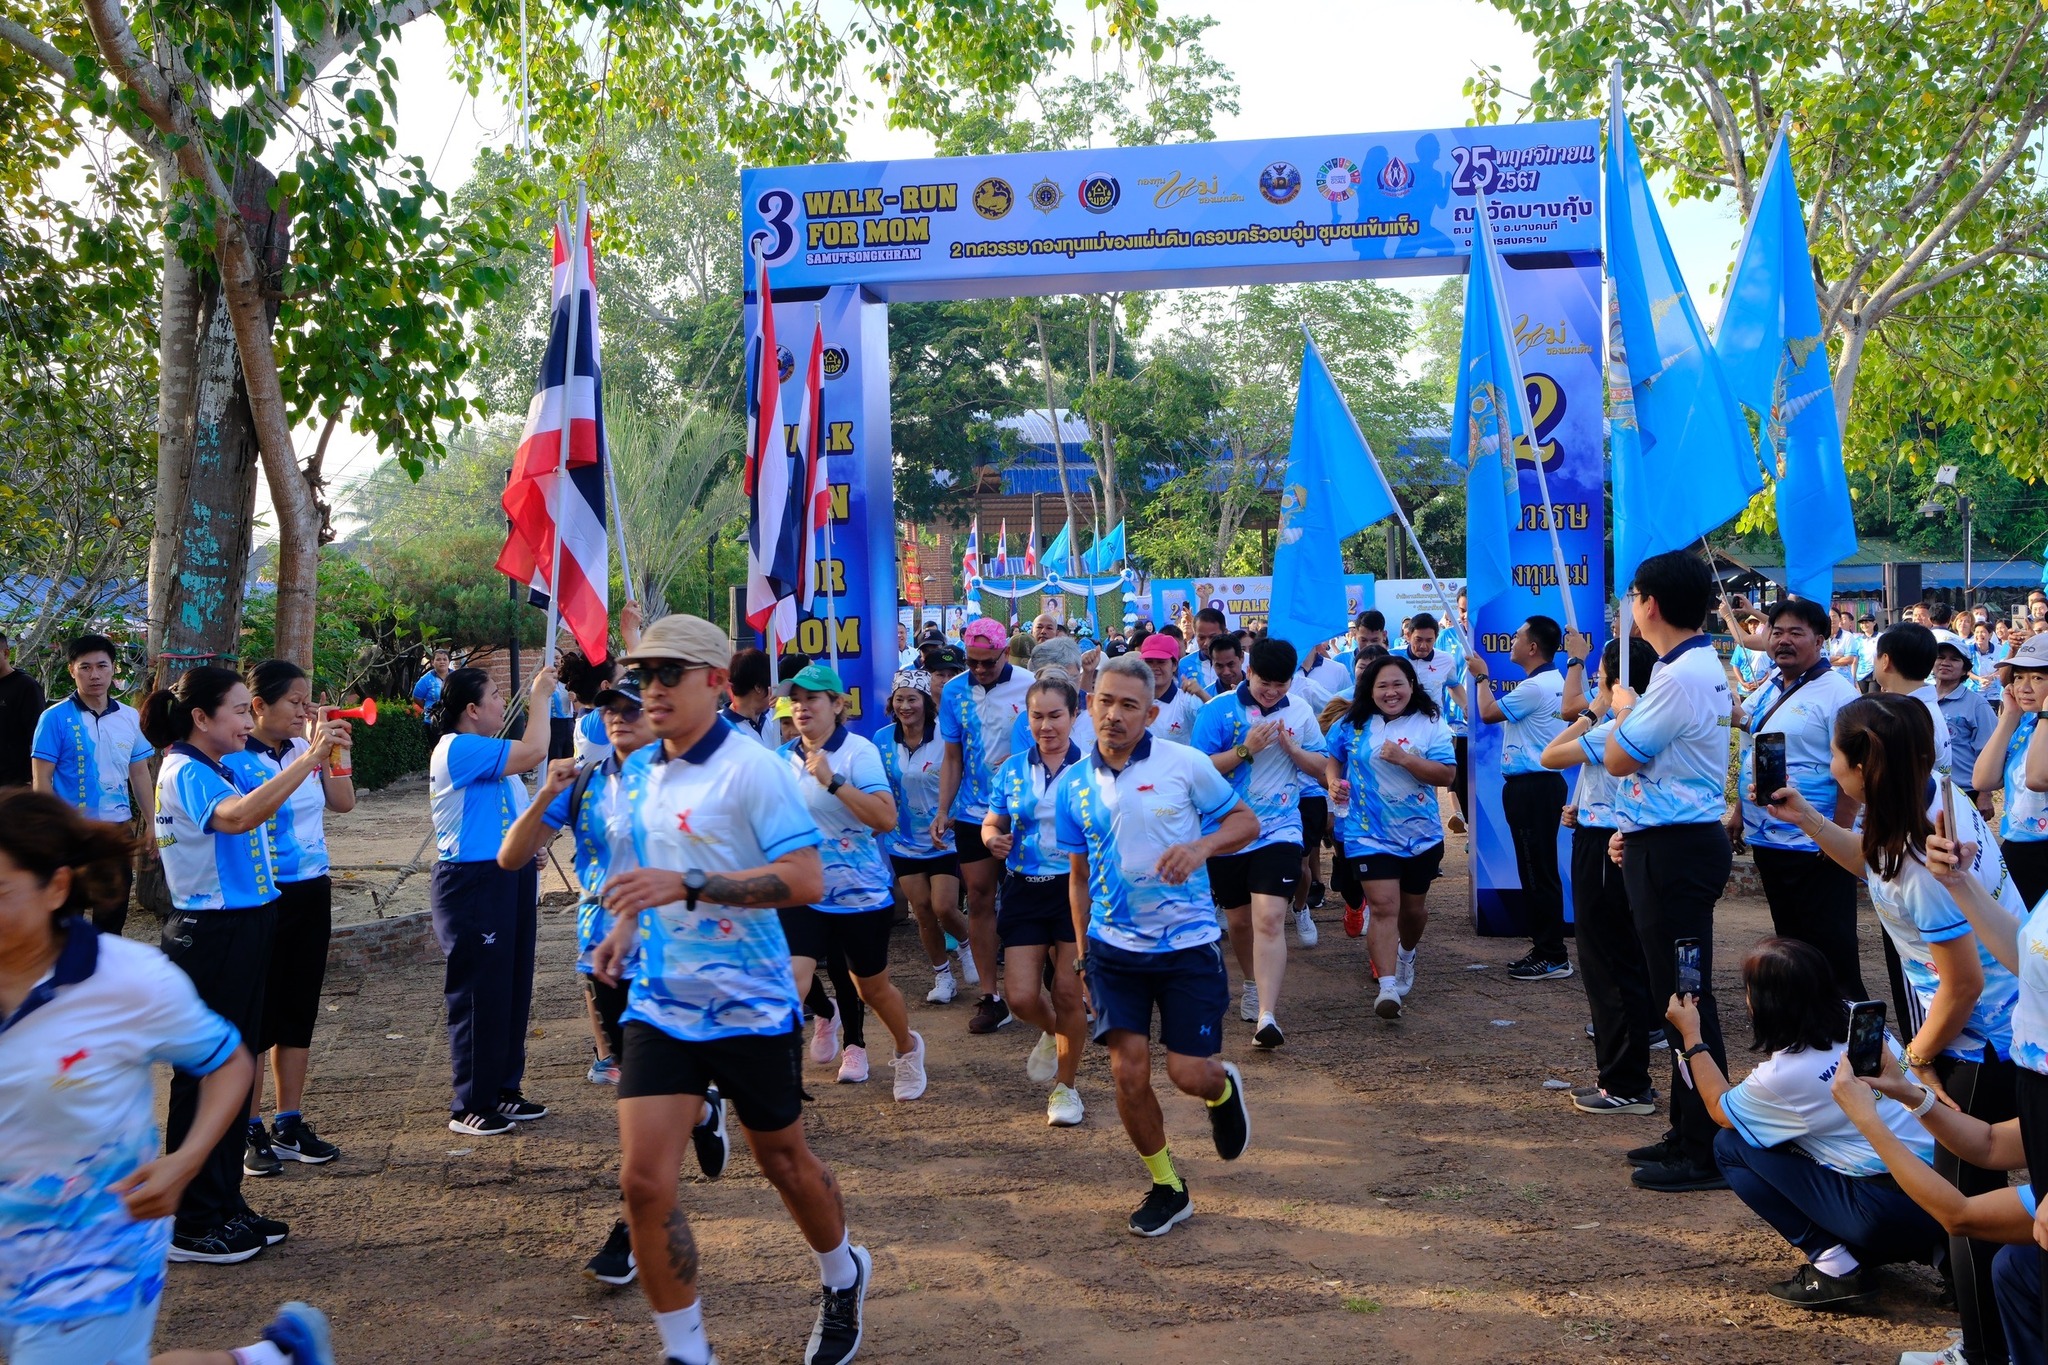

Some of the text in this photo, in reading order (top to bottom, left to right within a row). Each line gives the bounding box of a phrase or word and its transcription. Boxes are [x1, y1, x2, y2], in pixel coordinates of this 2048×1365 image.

[1451, 145, 1594, 194] 25 พฤศจิกายน
[1496, 171, 1539, 191] 2567
[1487, 196, 1593, 223] วัดบางกุ้ง
[750, 189, 798, 265] 3
[808, 217, 931, 249] FOR MOM
[951, 214, 1418, 258] 2 ทศวรรษ กองทุนแม่ของแผ่นดิน ครอบครัวอบอุ่น ชุมชนเข้มแข็ง
[1503, 221, 1558, 231] อ.บางคนที
[806, 249, 921, 264] SAMUTSONGKHRAM
[1513, 374, 1565, 470] 2
[1170, 602, 1180, 620] 2
[1227, 599, 1270, 614] WALK
[961, 701, 969, 729] WALK
[72, 725, 84, 751] WALK
[79, 778, 87, 798] FOR
[581, 790, 593, 831] WALK
[1078, 787, 1092, 828] WALK
[254, 864, 268, 895] FOR
[1025, 875, 1055, 883] adidas
